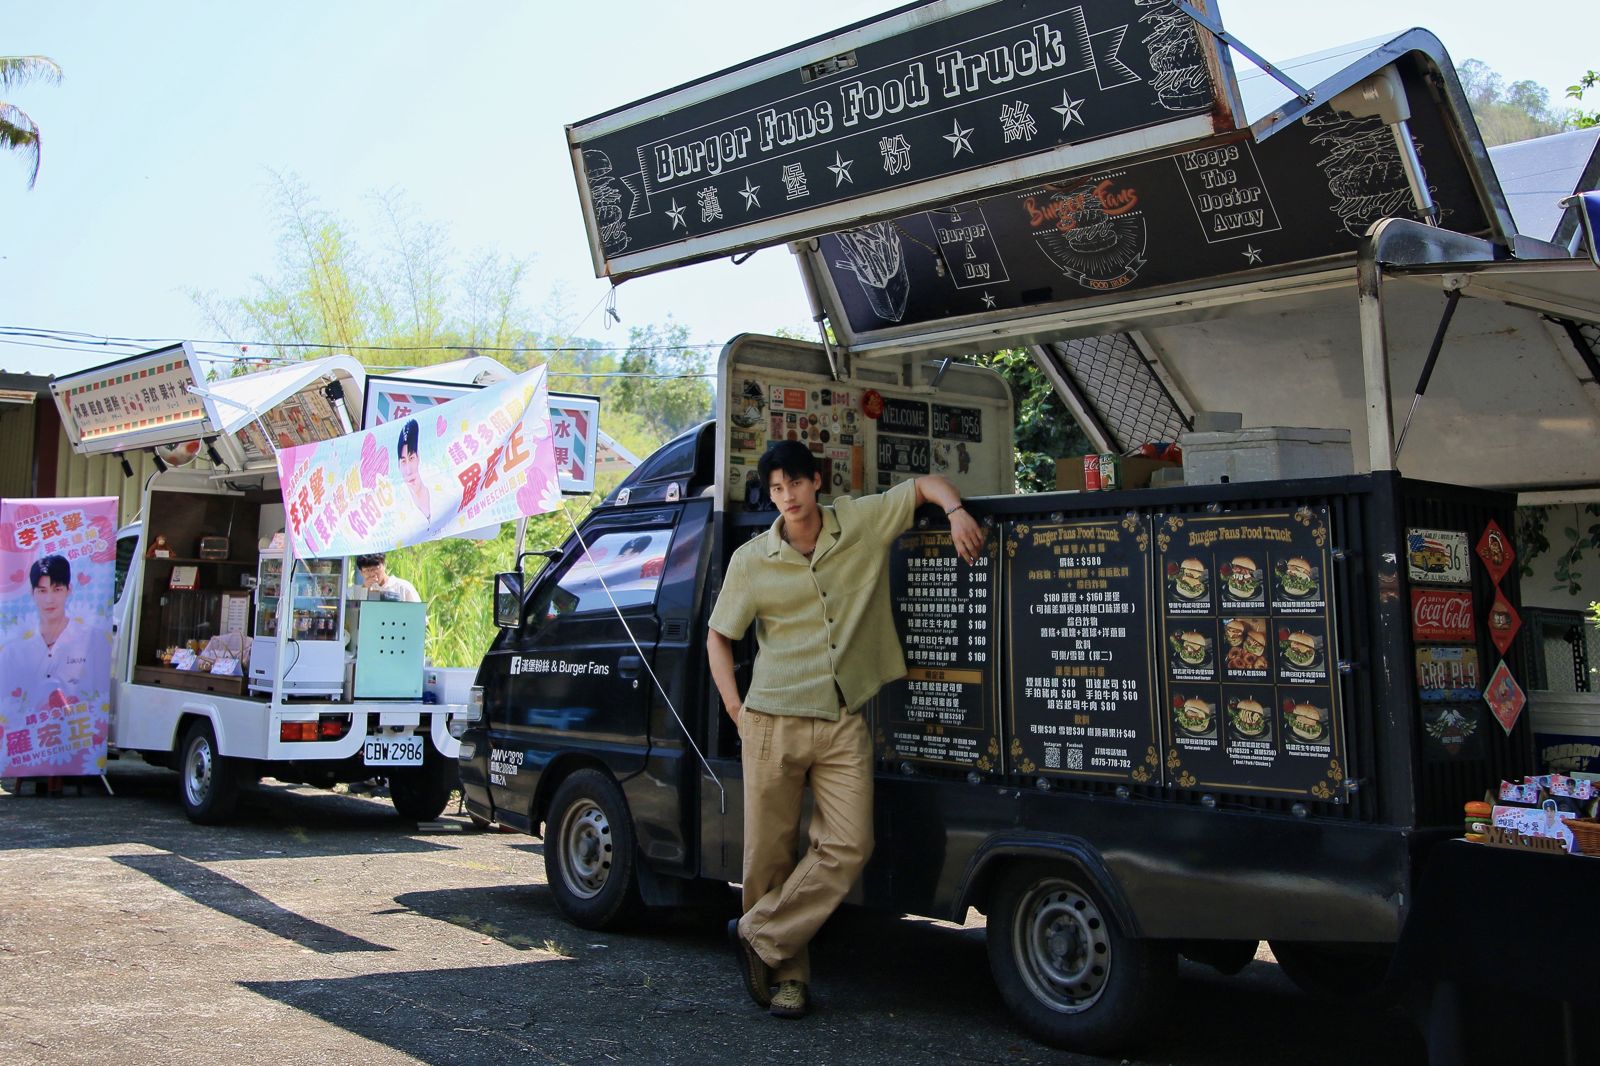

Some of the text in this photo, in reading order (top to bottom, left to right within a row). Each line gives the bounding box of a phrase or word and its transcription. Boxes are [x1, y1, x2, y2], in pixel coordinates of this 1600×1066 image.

[655, 23, 1066, 183] Burger Fans Food Truck
[697, 100, 1038, 223] 漢 堡 粉 絲
[1183, 145, 1239, 171] Keeps
[1201, 167, 1237, 189] The
[1092, 179, 1138, 215] Fans
[1199, 186, 1261, 213] Doctor
[951, 206, 961, 223] A
[1213, 207, 1263, 233] Away
[939, 224, 987, 245] Burger
[965, 243, 976, 260] A
[964, 260, 990, 280] Day
[1089, 275, 1130, 289] FOOD TRUCK
[933, 412, 979, 435] BUS 1956
[879, 443, 927, 467] HR 66
[348, 480, 393, 539] 你的心
[18, 512, 84, 546] 李武擎
[1033, 528, 1120, 547] Burger Fans Food Truck
[1188, 526, 1292, 547] Burger Fans Food Truck
[68, 539, 107, 560] 你的心
[1044, 593, 1060, 602] $180
[1086, 592, 1103, 602] $160
[1414, 595, 1470, 629] Coca-Cola
[521, 659, 550, 673] 漢堡粉絲
[551, 660, 558, 673] &
[559, 660, 588, 676] Burger
[588, 661, 610, 675] Fans
[1062, 678, 1076, 688] $10
[1122, 680, 1136, 689] $10
[1062, 689, 1076, 698] $60
[1123, 691, 1138, 701] $60
[7, 717, 94, 757] 羅宏正
[365, 742, 423, 761] CBW-2986
